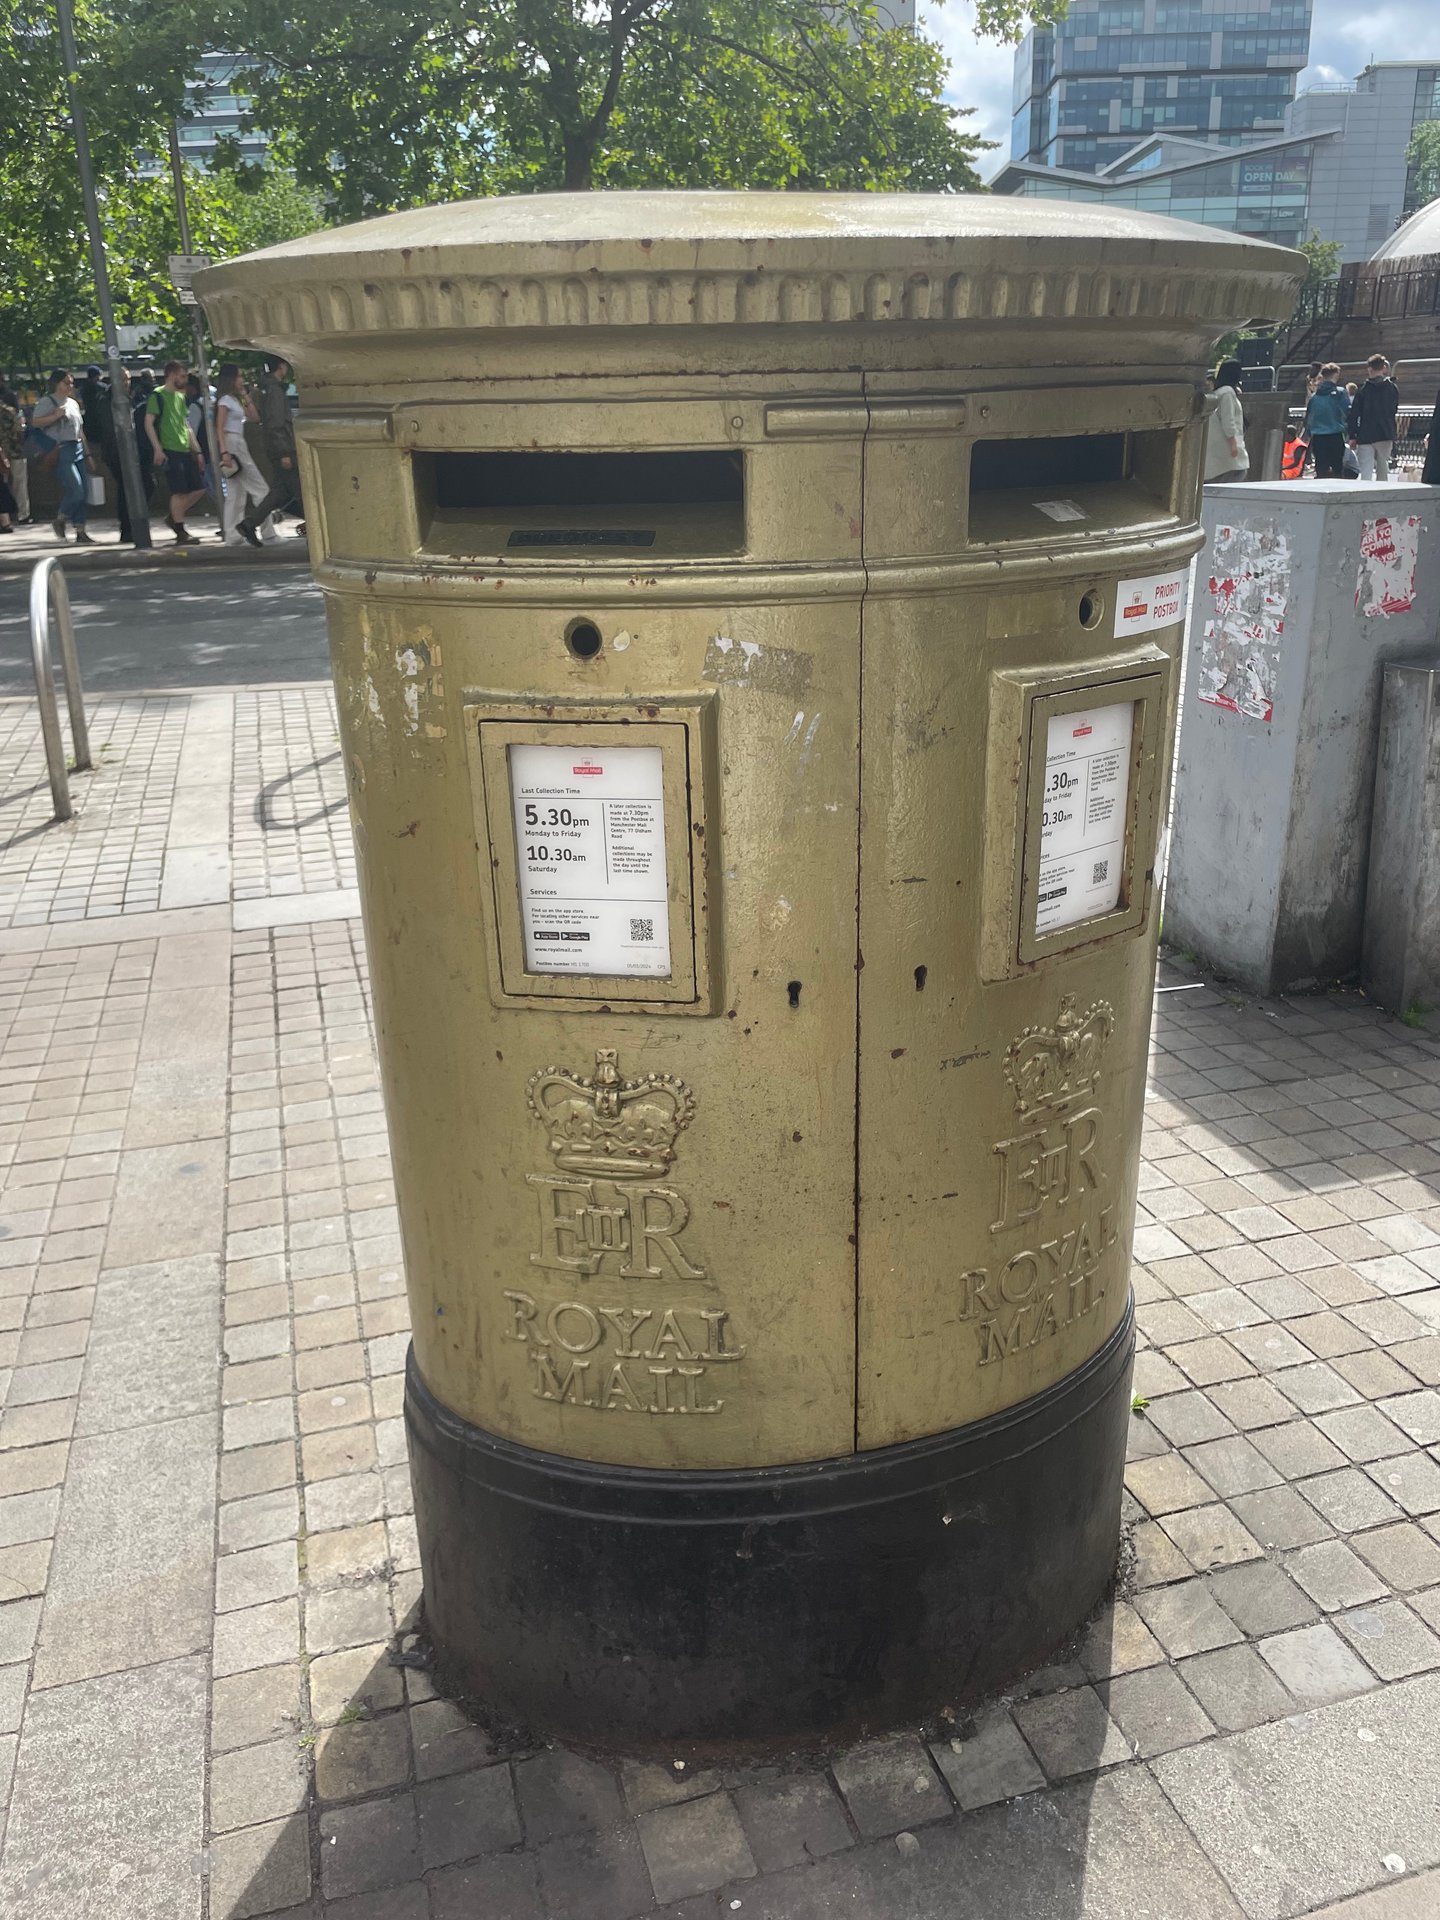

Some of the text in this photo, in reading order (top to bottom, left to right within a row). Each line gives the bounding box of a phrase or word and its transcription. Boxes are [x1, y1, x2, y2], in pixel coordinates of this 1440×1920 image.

[1244, 170, 1296, 182] OPEN DAY
[1155, 582, 1180, 599] PRIORITY
[1153, 601, 1179, 619] POSTBOX
[1046, 750, 1076, 763] Collection Time
[1046, 772, 1079, 793] .30pm
[1058, 791, 1072, 800] Friday
[525, 804, 590, 828] 5.30pm
[1042, 810, 1073, 827] 0.30am
[525, 830, 551, 838] Monday
[526, 845, 586, 861] 10.30am
[528, 865, 558, 873] Saturday
[959, 1204, 1119, 1322] ROYAL
[502, 1288, 748, 1362] ROYAL
[978, 1266, 1106, 1368] MAIL
[530, 1352, 725, 1415] MAIL
